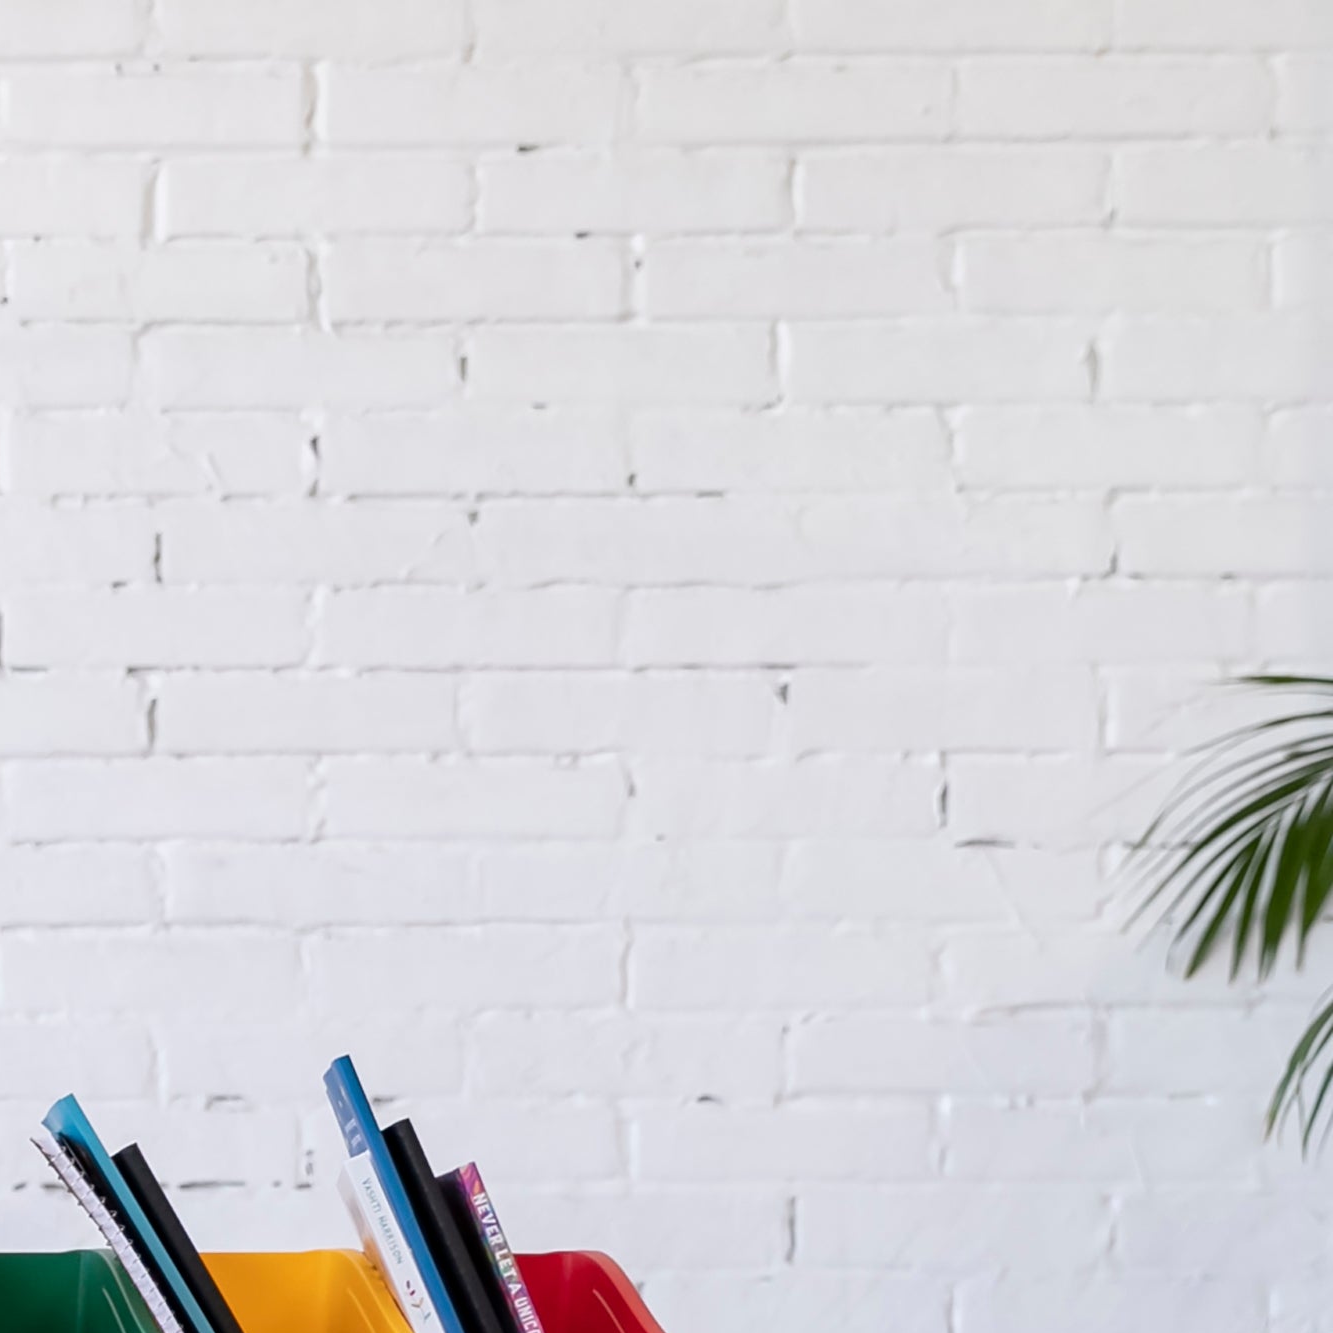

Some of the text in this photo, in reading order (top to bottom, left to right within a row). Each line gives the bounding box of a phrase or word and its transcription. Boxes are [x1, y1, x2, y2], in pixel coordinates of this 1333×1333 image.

[361, 1176, 403, 1266] VASHTI HARRISON
[473, 1191, 504, 1249] NEVER
[494, 1248, 518, 1282] LET
[508, 1281, 522, 1295] A
